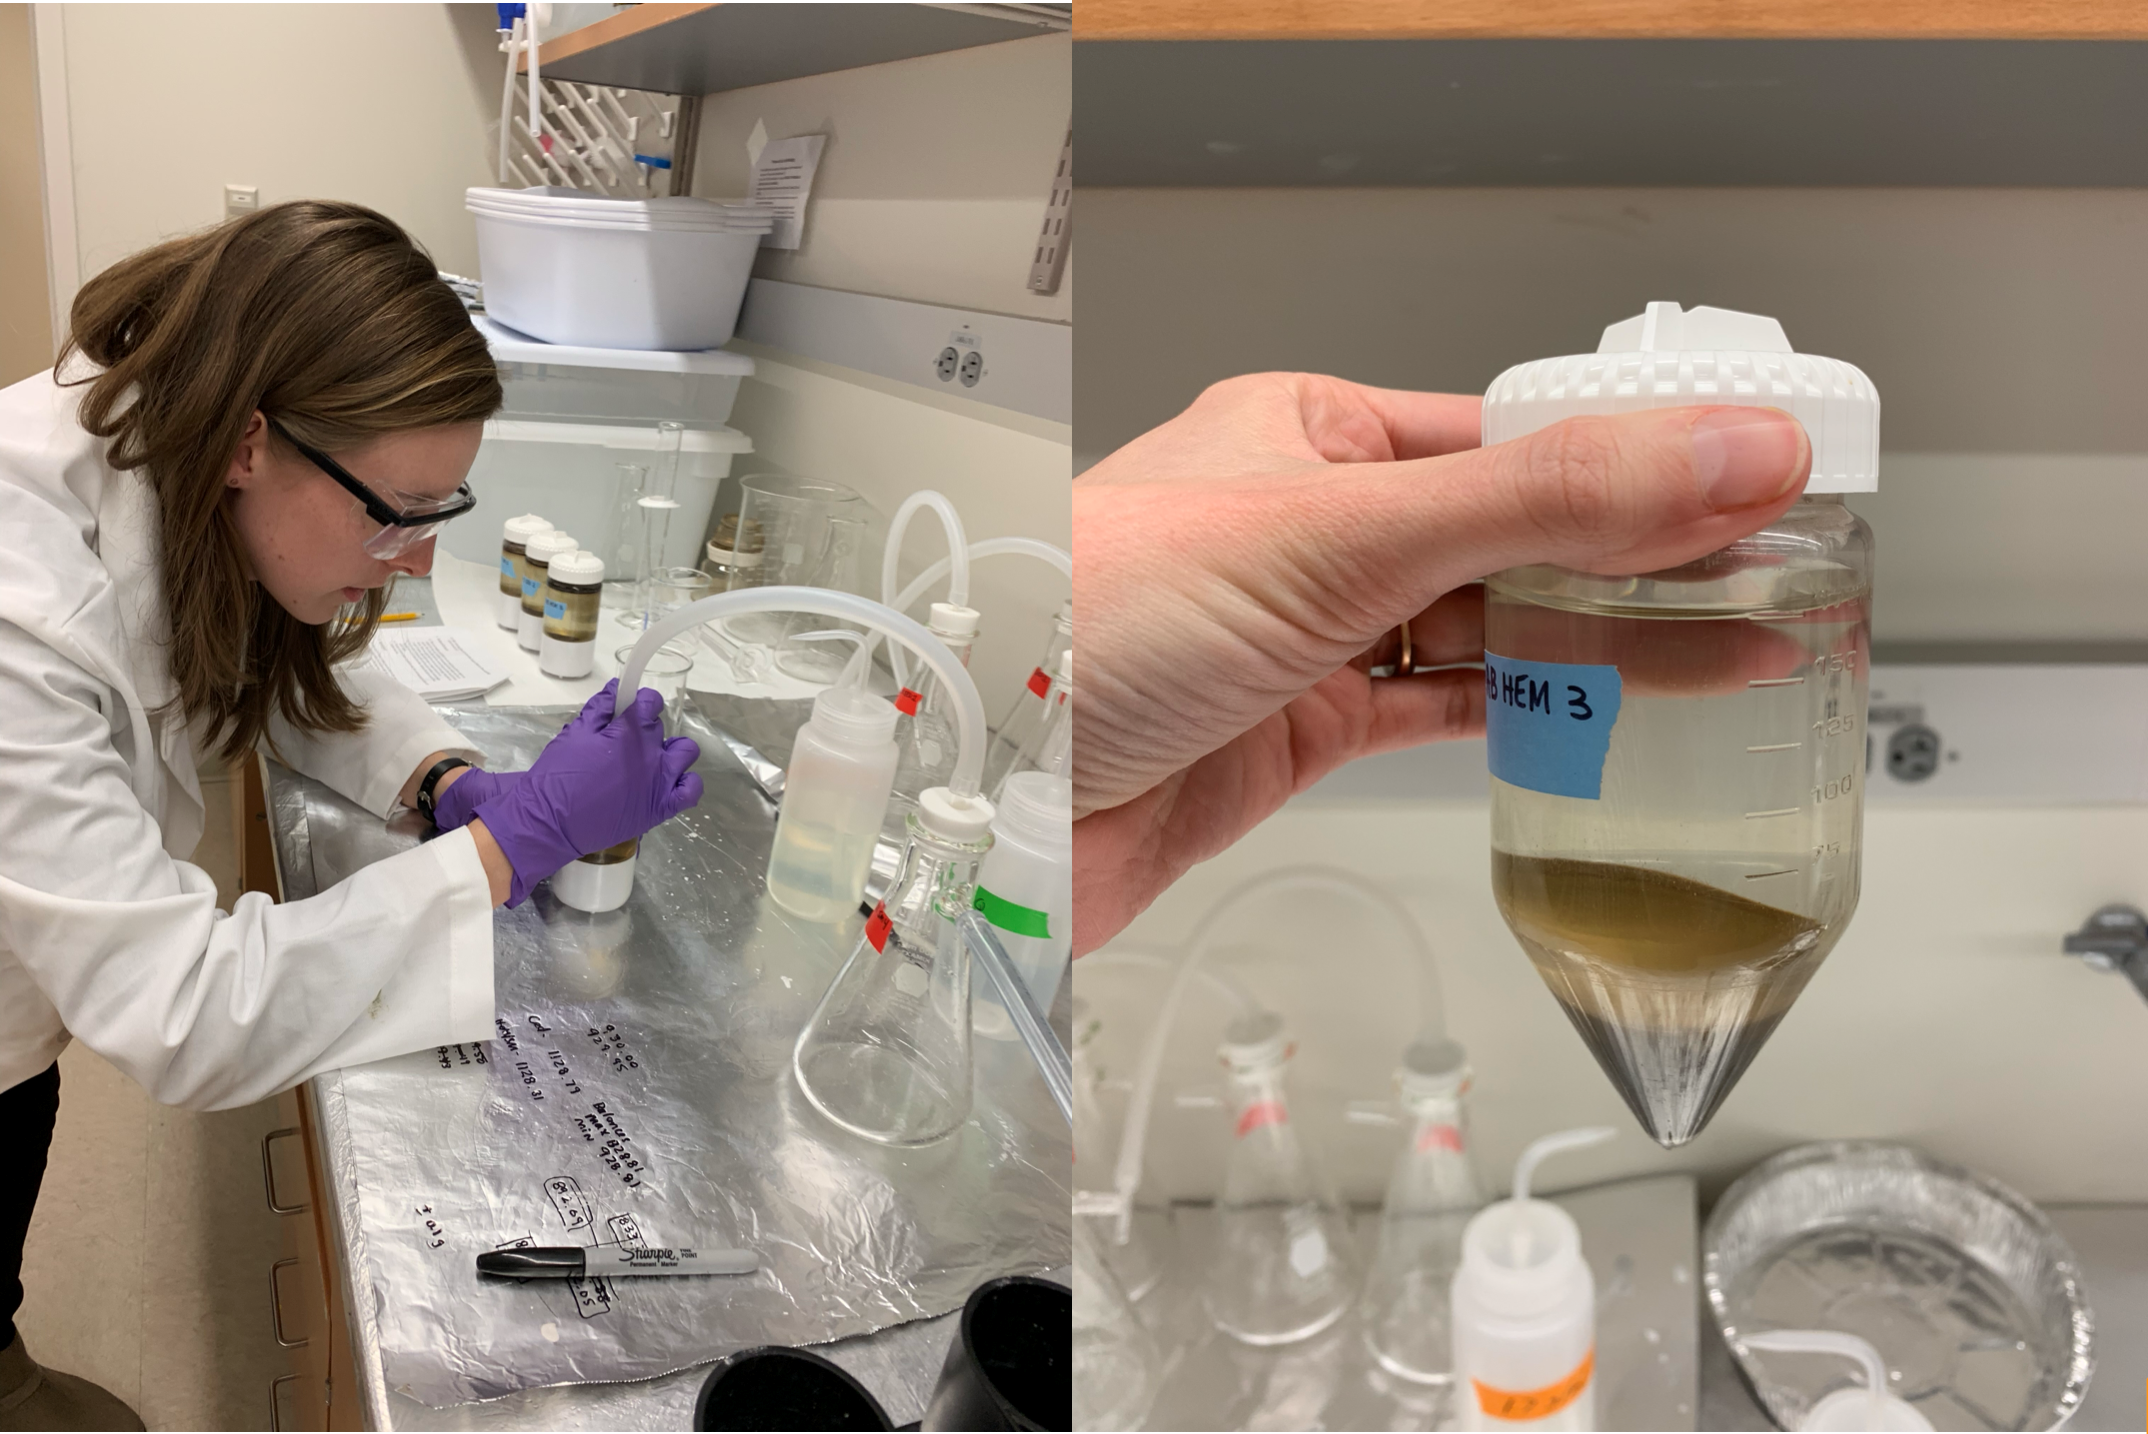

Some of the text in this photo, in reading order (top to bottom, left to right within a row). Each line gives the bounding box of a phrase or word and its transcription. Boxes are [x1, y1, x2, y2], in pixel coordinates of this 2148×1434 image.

[1814, 650, 1858, 676] 150
[1502, 671, 1551, 716] HEM
[1566, 684, 1594, 721] 3
[1812, 713, 1855, 739] 125
[1810, 774, 1852, 804] 100
[1811, 841, 1840, 865] 75
[515, 1061, 545, 1101] 1128.31
[599, 1146, 641, 1188] 928.81
[618, 1247, 677, 1263] Sharpie
